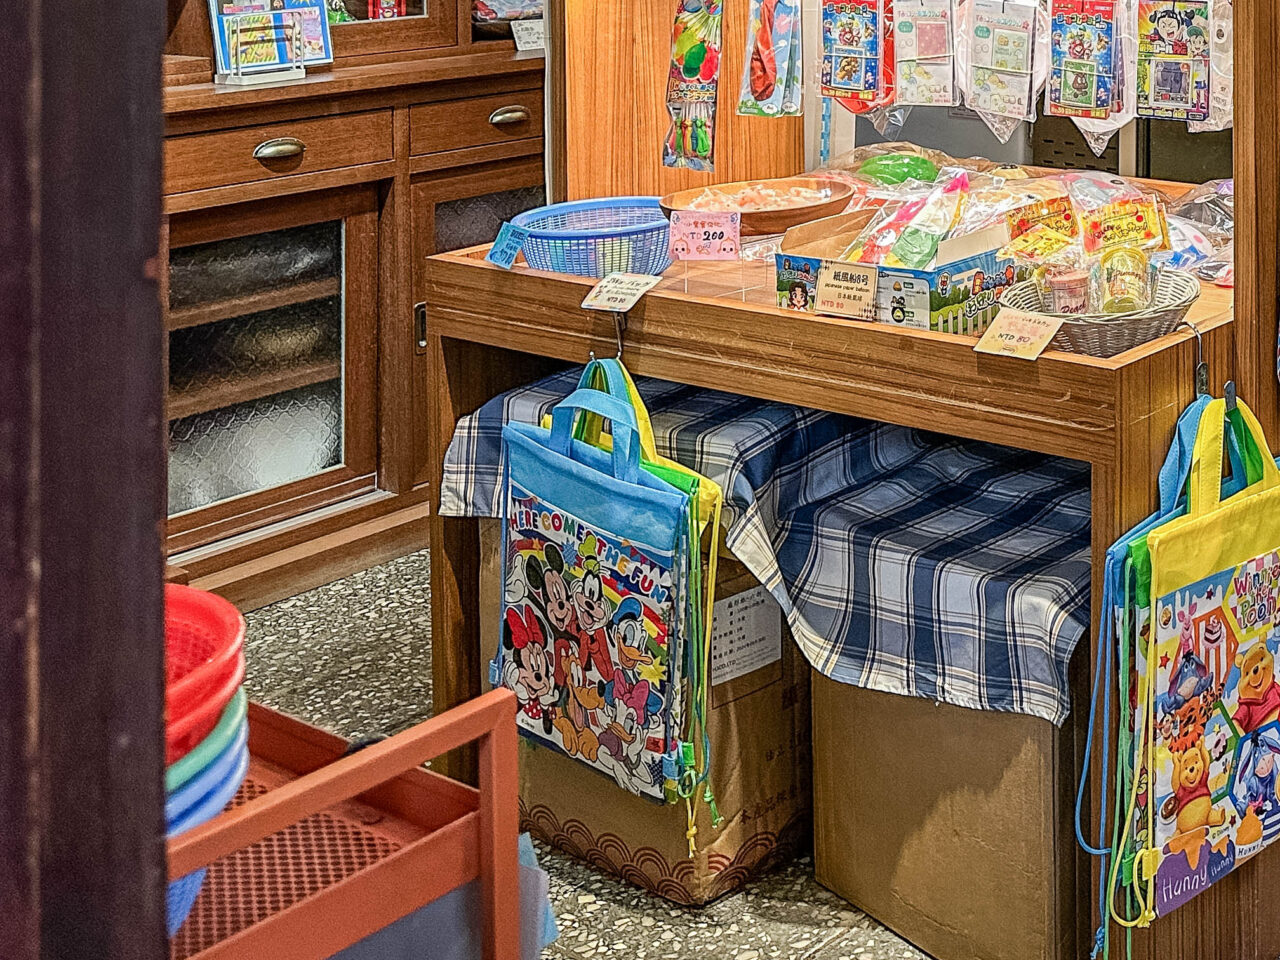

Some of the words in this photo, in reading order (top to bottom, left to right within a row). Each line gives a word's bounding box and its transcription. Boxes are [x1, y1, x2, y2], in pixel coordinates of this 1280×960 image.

[682, 231, 702, 240] NTD
[702, 230, 725, 241] 200
[510, 512, 539, 531] HERE
[596, 538, 629, 573] THE
[632, 569, 668, 604] FUN
[1240, 592, 1277, 629] Pooh
